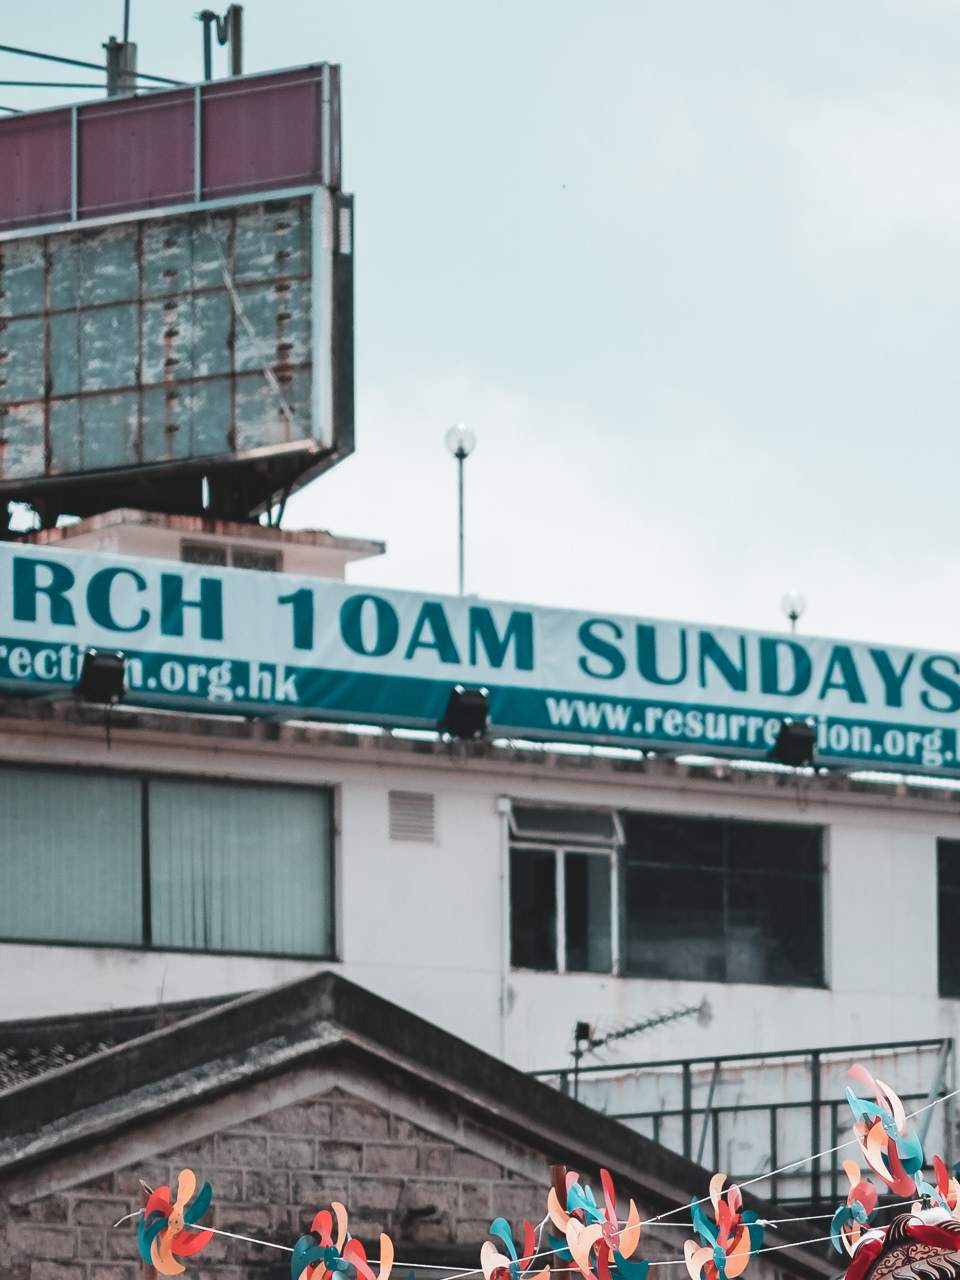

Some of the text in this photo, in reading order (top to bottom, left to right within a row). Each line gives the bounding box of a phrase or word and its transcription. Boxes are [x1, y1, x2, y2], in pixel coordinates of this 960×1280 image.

[12, 556, 224, 642] RCH
[277, 587, 535, 672] 10AM
[0, 643, 299, 703] ectin.org.hk
